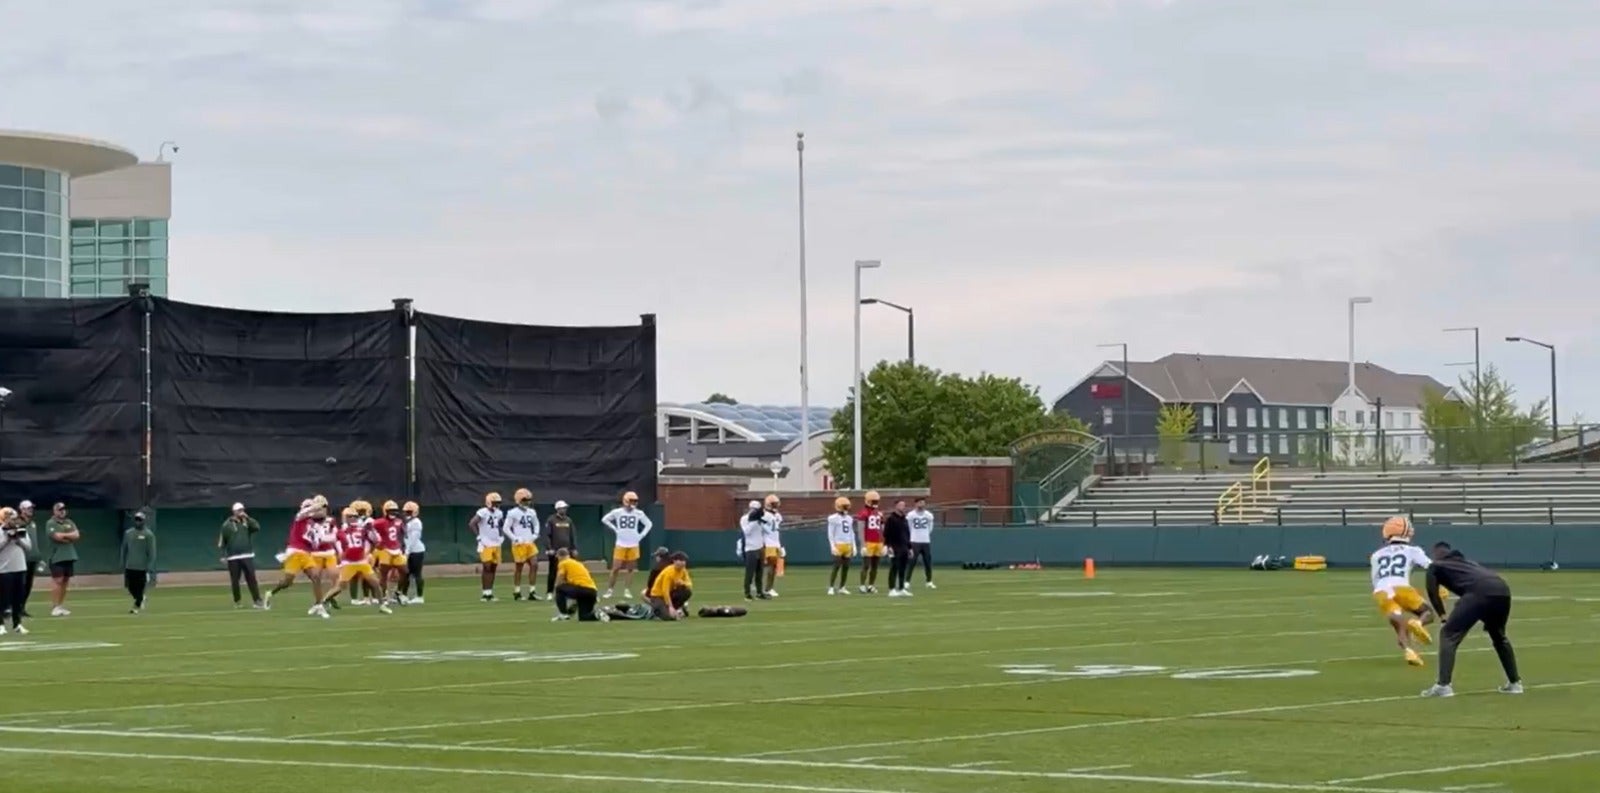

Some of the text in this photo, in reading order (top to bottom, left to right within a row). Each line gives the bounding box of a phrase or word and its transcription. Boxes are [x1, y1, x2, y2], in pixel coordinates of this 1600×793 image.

[619, 515, 636, 529] 88
[842, 520, 850, 533] 6
[913, 517, 928, 529] 82
[388, 526, 398, 541] 2
[1378, 554, 1407, 578] 22
